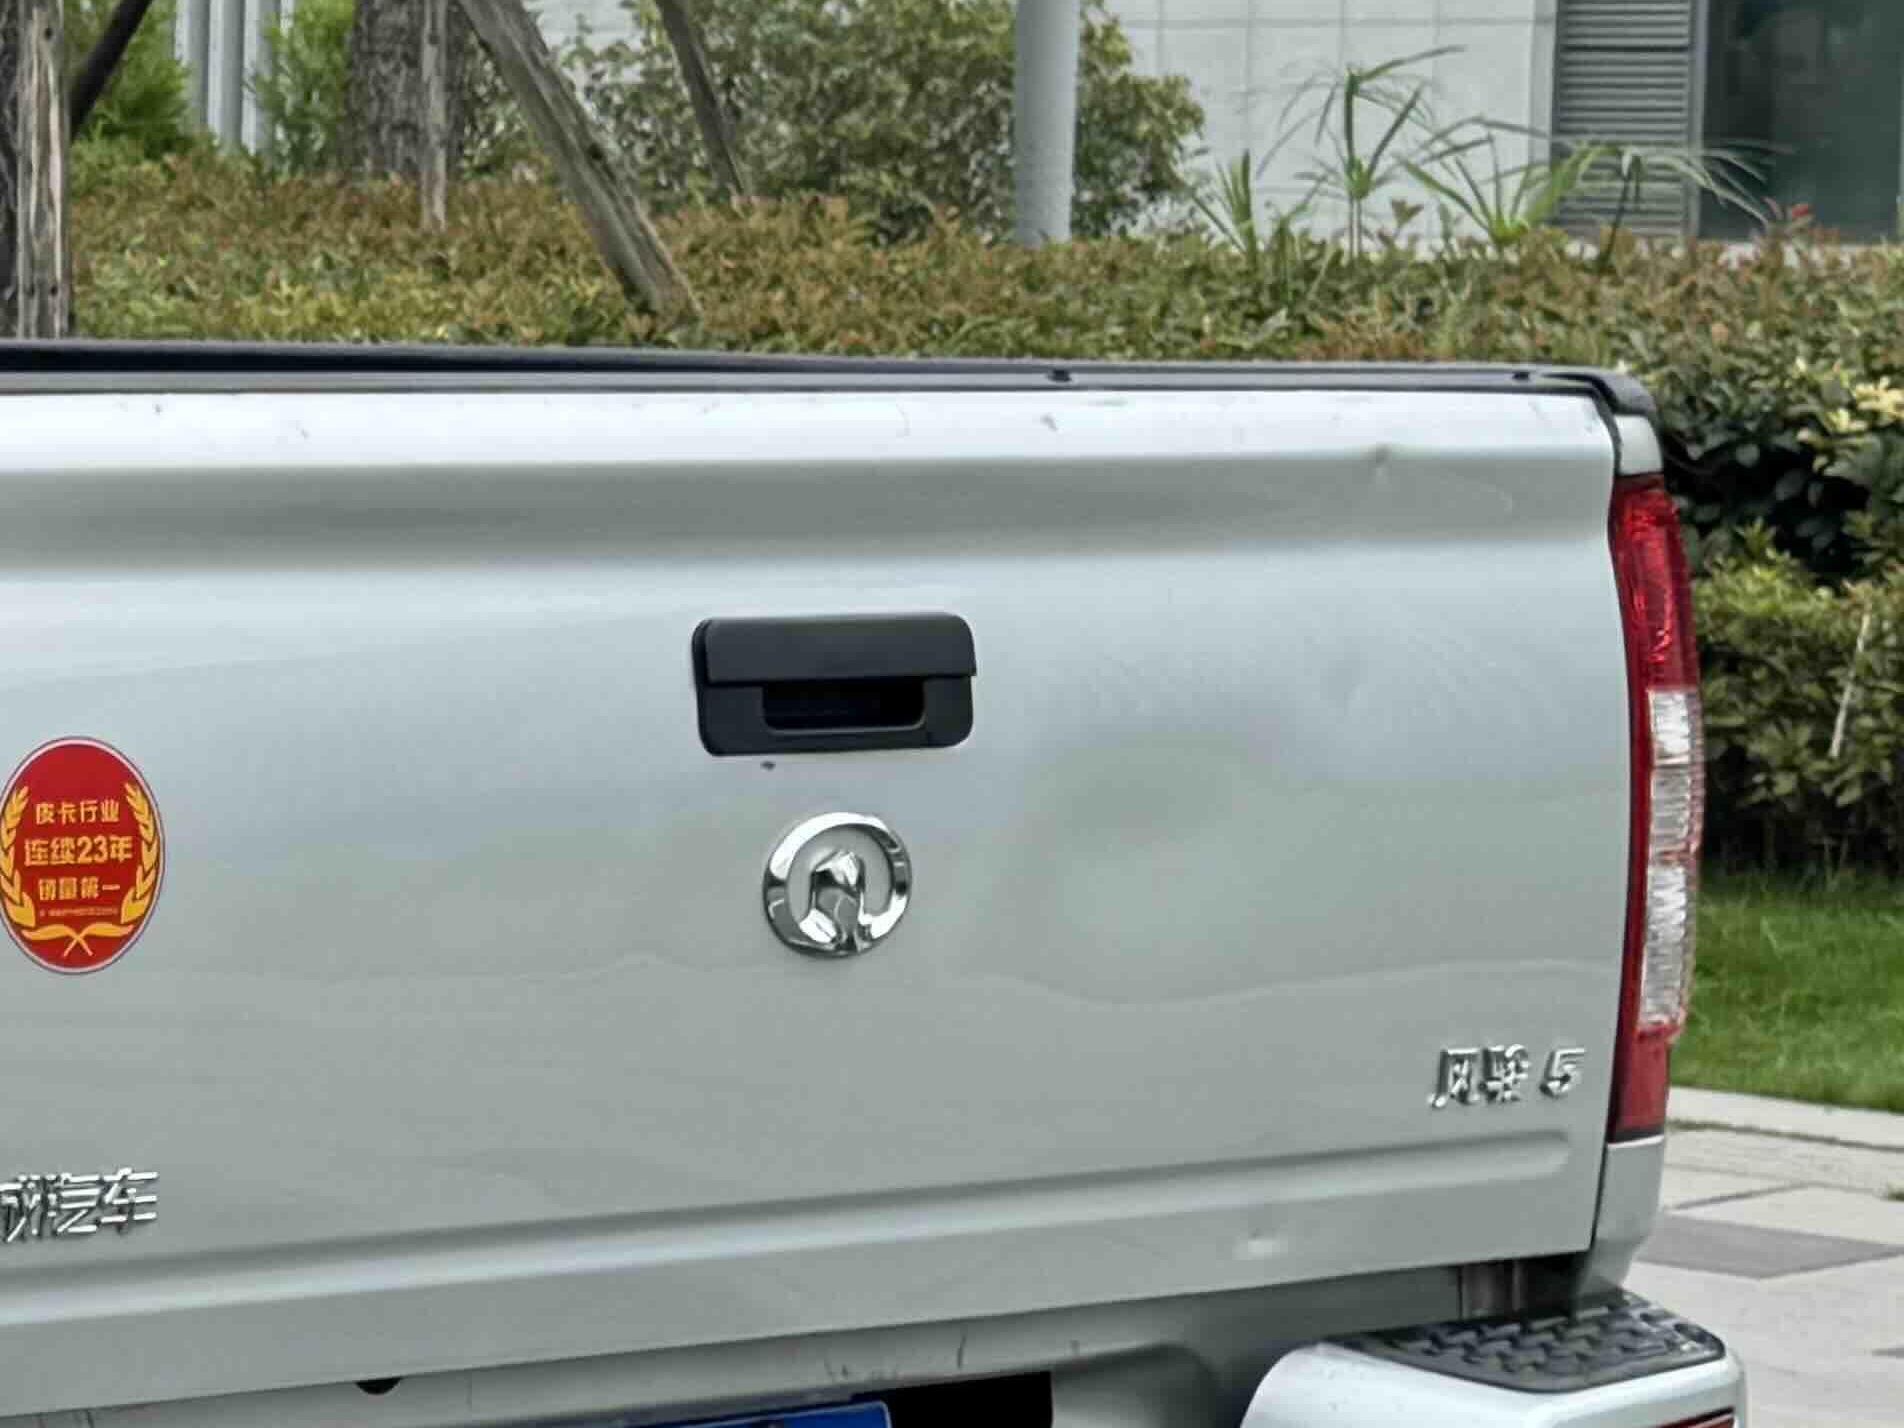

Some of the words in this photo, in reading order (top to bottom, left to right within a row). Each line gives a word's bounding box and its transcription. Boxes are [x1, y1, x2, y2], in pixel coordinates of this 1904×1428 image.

[35, 799, 120, 825] 皮卡行业
[24, 835, 133, 867] 连续23年
